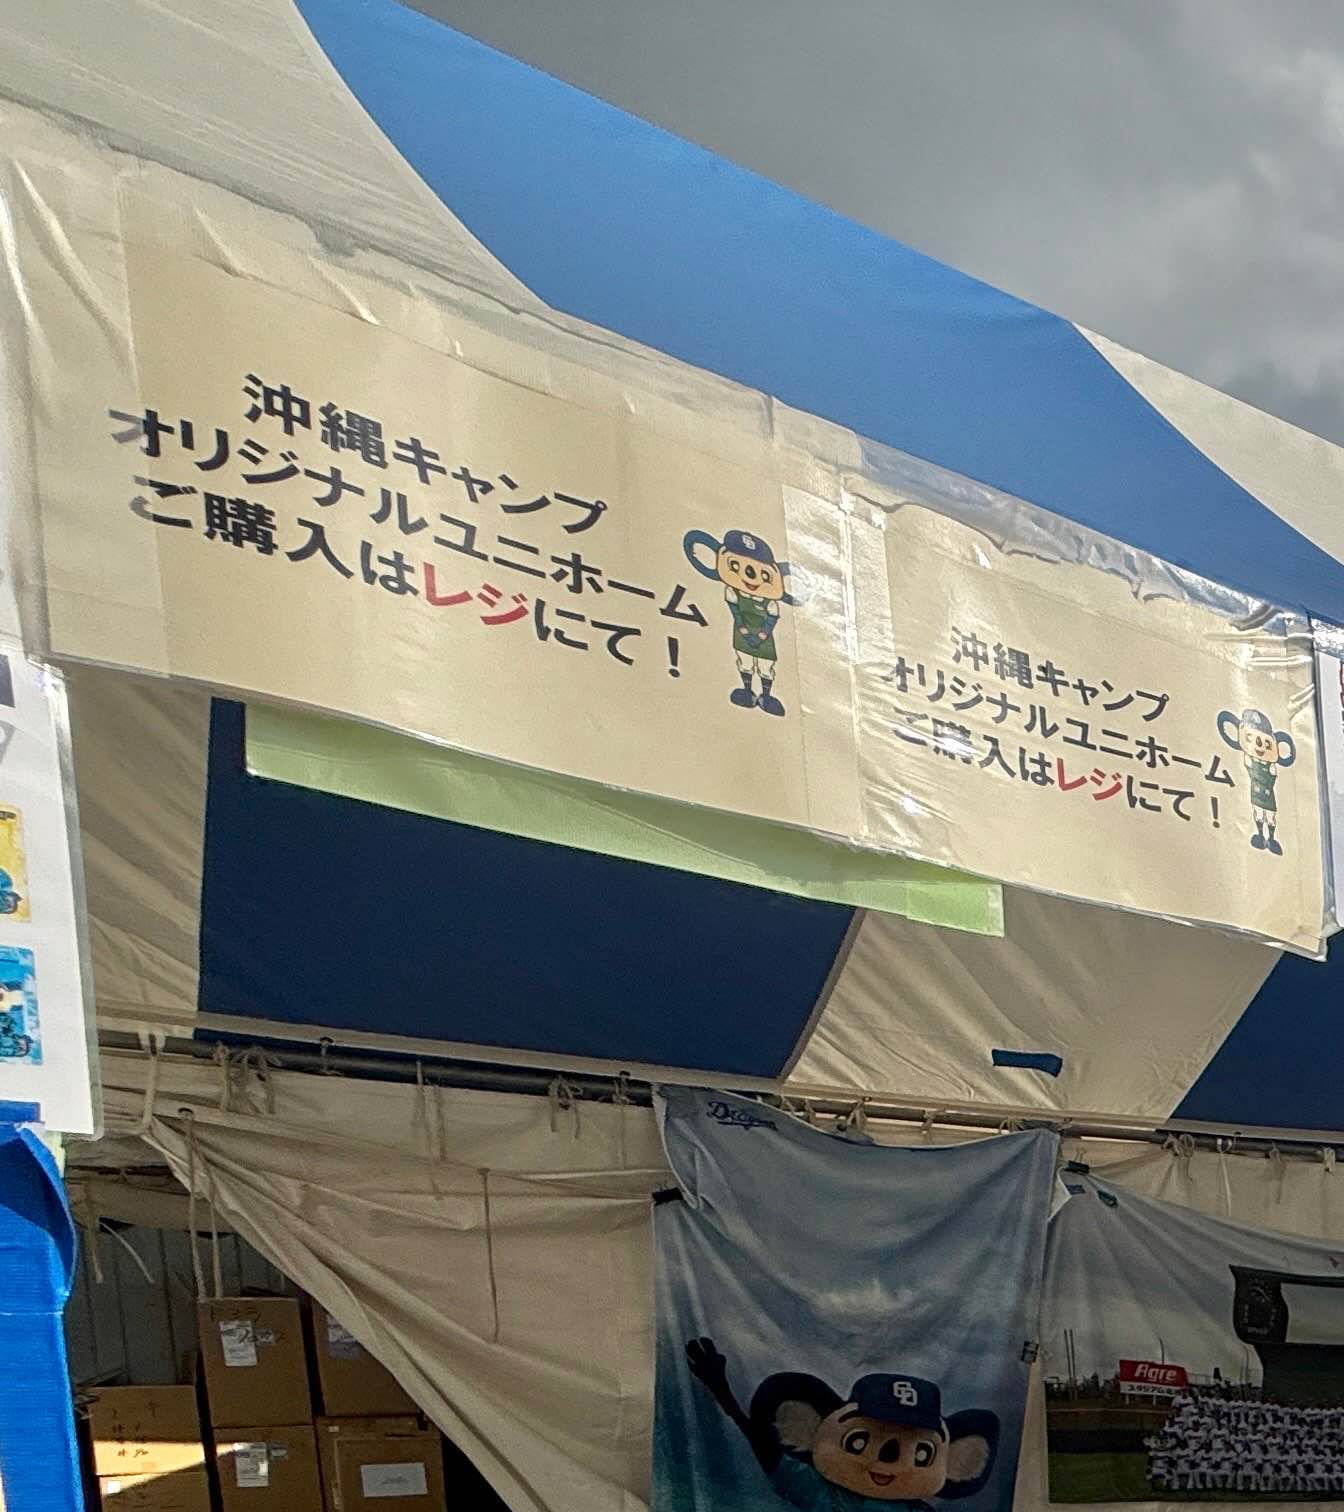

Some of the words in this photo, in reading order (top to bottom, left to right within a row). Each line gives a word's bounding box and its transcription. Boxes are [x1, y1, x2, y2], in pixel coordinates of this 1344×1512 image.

[108, 408, 711, 628] オリジナルユニホーム
[242, 374, 608, 533] 沖縄キャンプ
[130, 474, 684, 679] ご購入はレジにて！
[884, 657, 1236, 788] オリジナルユニホーム
[951, 626, 1170, 722] 沖縄キャンプ
[1134, 1363, 1177, 1382] Agre
